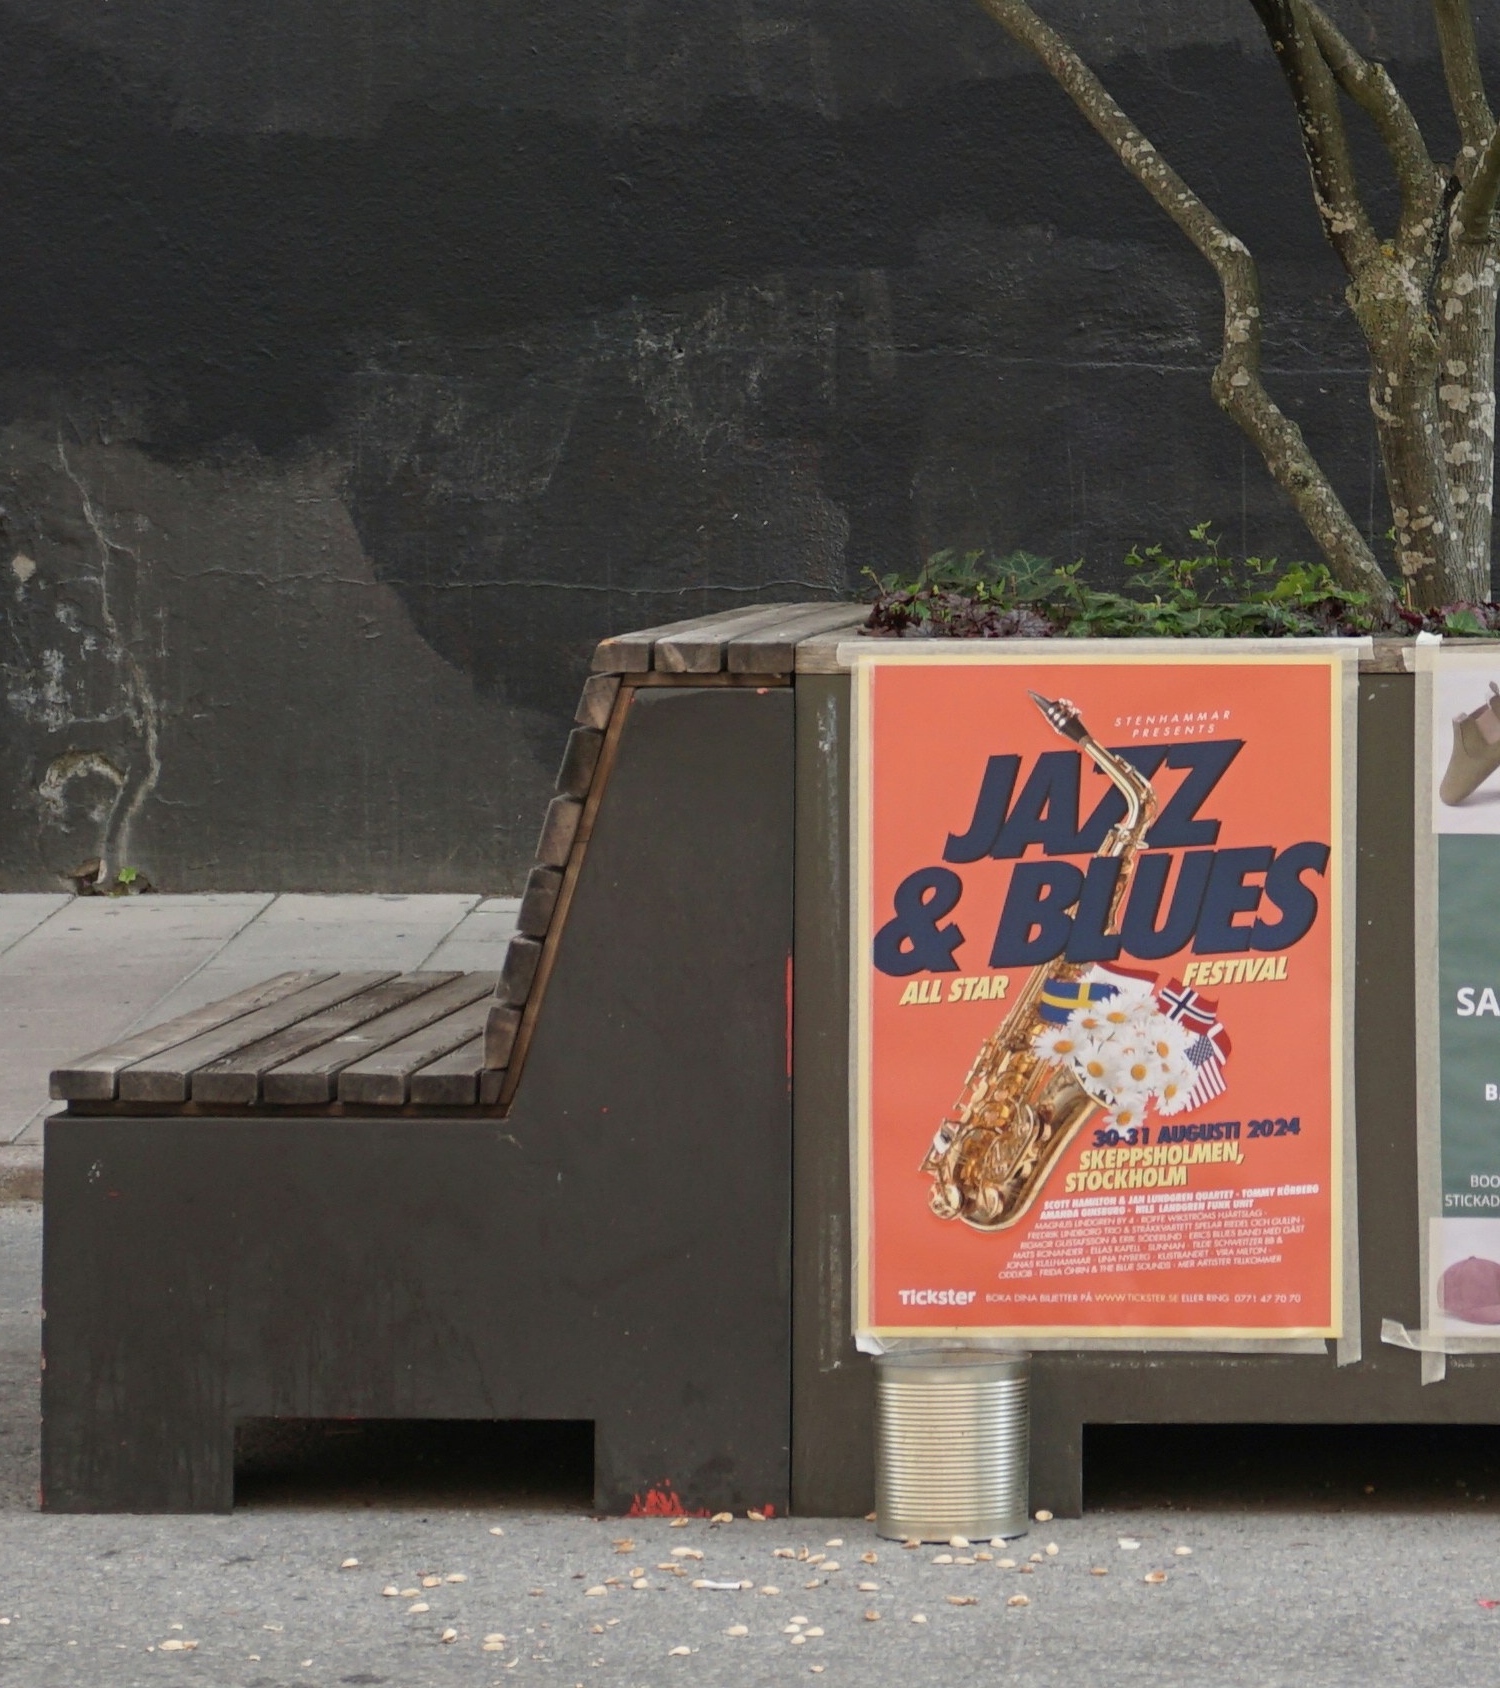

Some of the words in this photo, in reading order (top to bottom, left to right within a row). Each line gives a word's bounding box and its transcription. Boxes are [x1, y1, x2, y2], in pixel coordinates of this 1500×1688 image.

[1114, 710, 1231, 728] STENHAMMAR
[1132, 723, 1216, 738] PRESENTS
[943, 739, 1246, 863] JAZZ
[873, 866, 966, 978] &
[989, 841, 1332, 969] BLUES
[1182, 956, 1288, 988] FESTIVAL
[899, 980, 943, 1006] ALL
[947, 976, 1010, 1002] STAR
[1092, 1127, 1150, 1148] 30-31
[1158, 1122, 1241, 1144] AUGUSTI
[1247, 1117, 1301, 1139] 2024
[1079, 1142, 1245, 1171] SKEPPSHOLMEN,
[1065, 1165, 1188, 1194] STOCKHOLM
[898, 1289, 976, 1306] Tickster
[986, 1294, 1011, 1303] BOKA
[1014, 1294, 1037, 1303] DINA
[1040, 1294, 1078, 1303] BILJETTER
[1081, 1292, 1092, 1303] PÅ
[1095, 1294, 1178, 1303] WWW.TICKSTER.SE
[1181, 1294, 1204, 1303] ELLER
[1206, 1294, 1229, 1303] RING
[1234, 1294, 1256, 1304] 0771
[1260, 1294, 1272, 1304] 47
[1275, 1294, 1287, 1304] 70
[1289, 1294, 1301, 1304] 70
